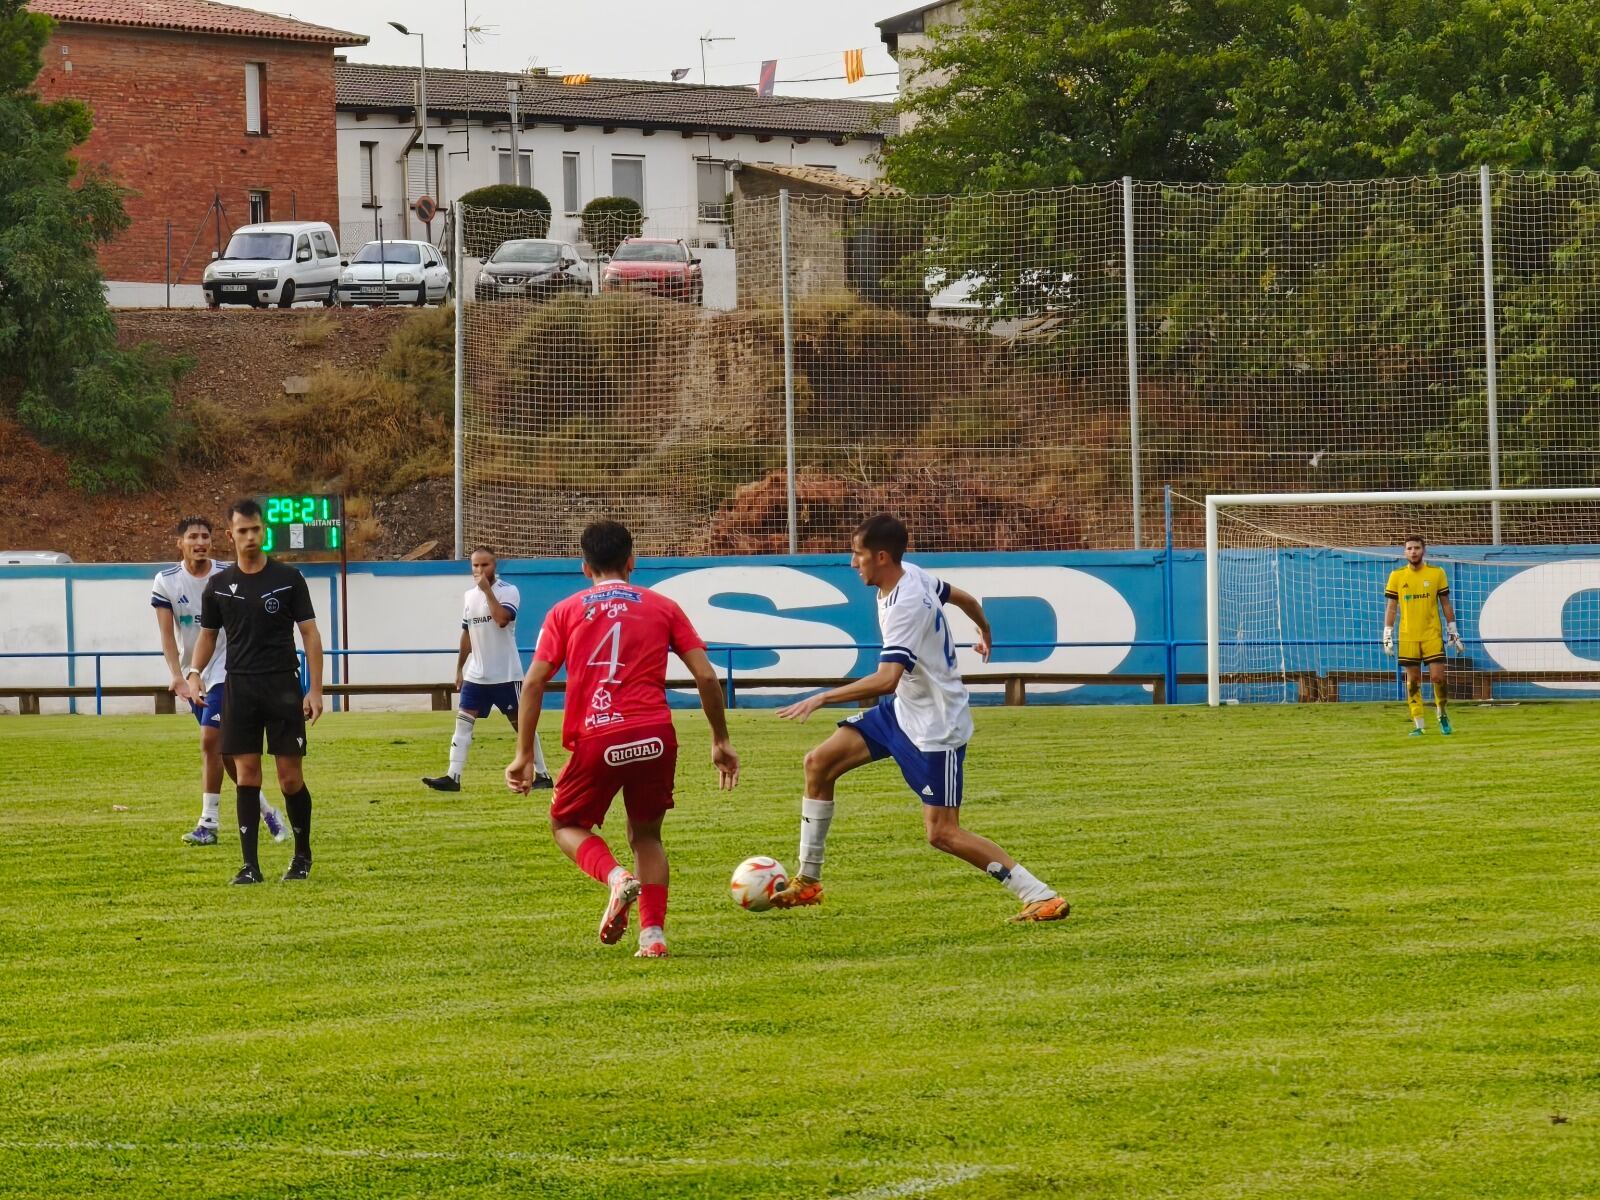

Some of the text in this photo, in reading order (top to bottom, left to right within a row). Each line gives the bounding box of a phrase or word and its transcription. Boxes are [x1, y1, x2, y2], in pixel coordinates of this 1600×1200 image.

[267, 497, 328, 523] 29:21
[304, 519, 341, 527] VISITANTE
[586, 621, 626, 684] 4
[610, 743, 659, 762] RIGUAL
